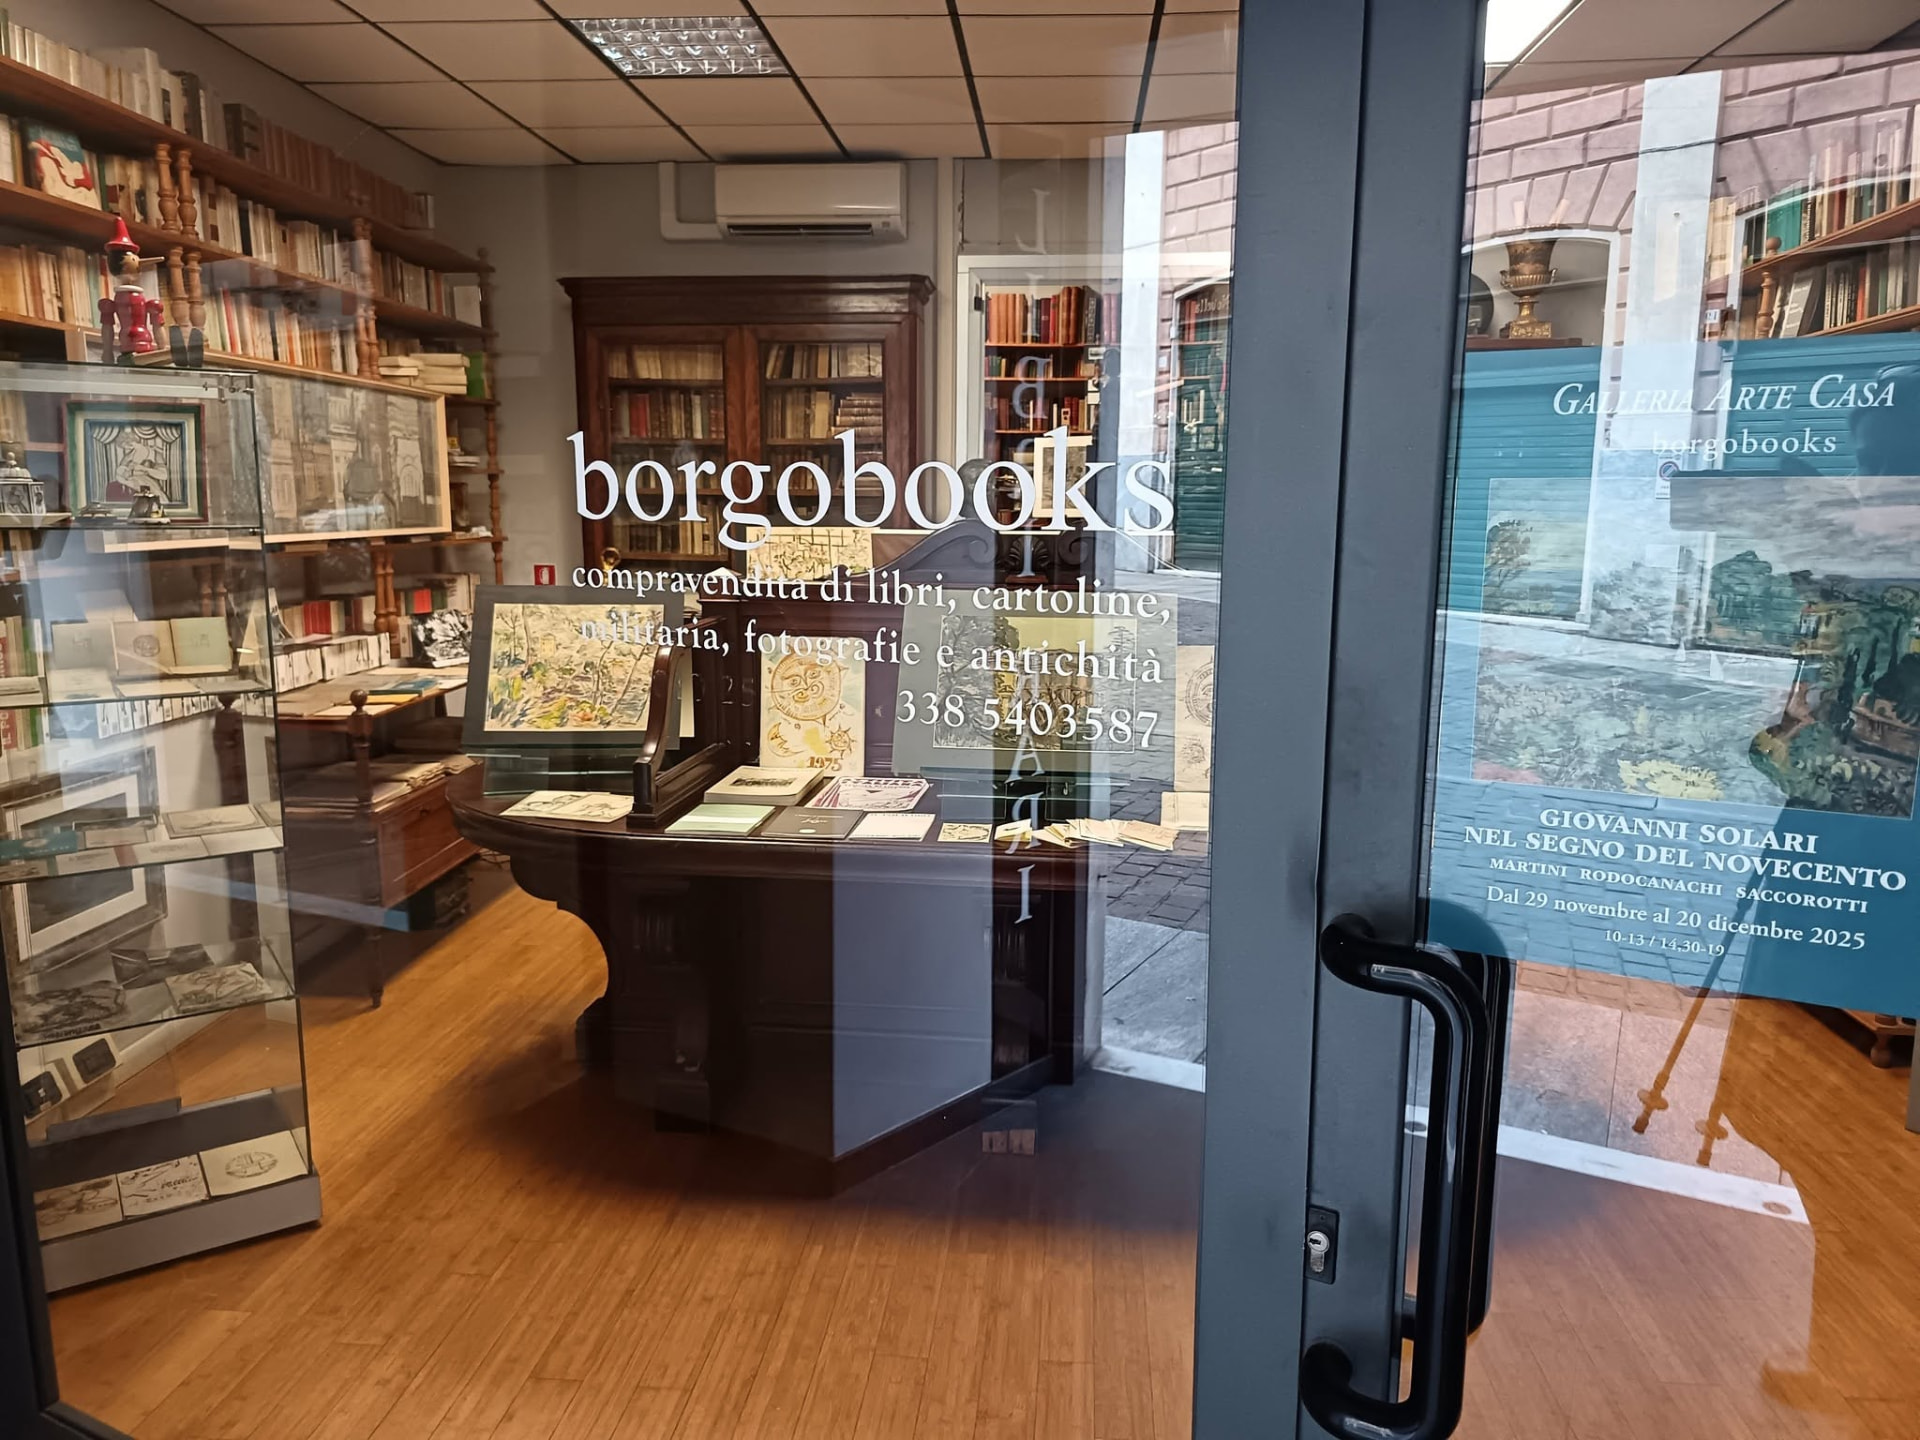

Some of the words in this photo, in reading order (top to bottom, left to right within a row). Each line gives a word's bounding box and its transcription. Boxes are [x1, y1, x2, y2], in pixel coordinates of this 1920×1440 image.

[1553, 382, 1694, 416] GALLERIA
[1704, 379, 1796, 412] ARTE
[1809, 373, 1896, 410] CASA
[1652, 426, 1837, 462] borgobooks
[567, 429, 1176, 551] borgobooks
[572, 563, 808, 602] compravendita
[820, 562, 853, 602] di
[865, 567, 957, 612] libri,
[971, 578, 1172, 625] cartoline,
[581, 609, 731, 656] militaria,
[744, 620, 922, 667] fotografie
[937, 641, 956, 668] e
[970, 641, 1163, 684] antichità
[897, 689, 966, 729] 338
[982, 696, 1159, 749] 5403587
[807, 756, 843, 772] 1975
[1463, 826, 1517, 849] NEL
[1525, 832, 1625, 861] SEGNO
[1635, 842, 1694, 869] DEL
[1703, 852, 1907, 893] NOVECENTO
[1539, 808, 1689, 842] GIOVANNI
[1699, 824, 1819, 855] SOLARI
[1489, 857, 1568, 879] MARTINI
[1580, 868, 1723, 897] RODOCANACHI
[1735, 886, 1869, 914] SACCOROTTI
[1487, 885, 1520, 906] Dal
[1524, 891, 1549, 910] 29
[1554, 896, 1648, 923] novembre
[1653, 908, 1670, 925] al
[1676, 911, 1702, 929] 20
[1708, 913, 1804, 942] dicembre
[1810, 926, 1867, 951] 2025
[1604, 929, 1646, 947] 10-13
